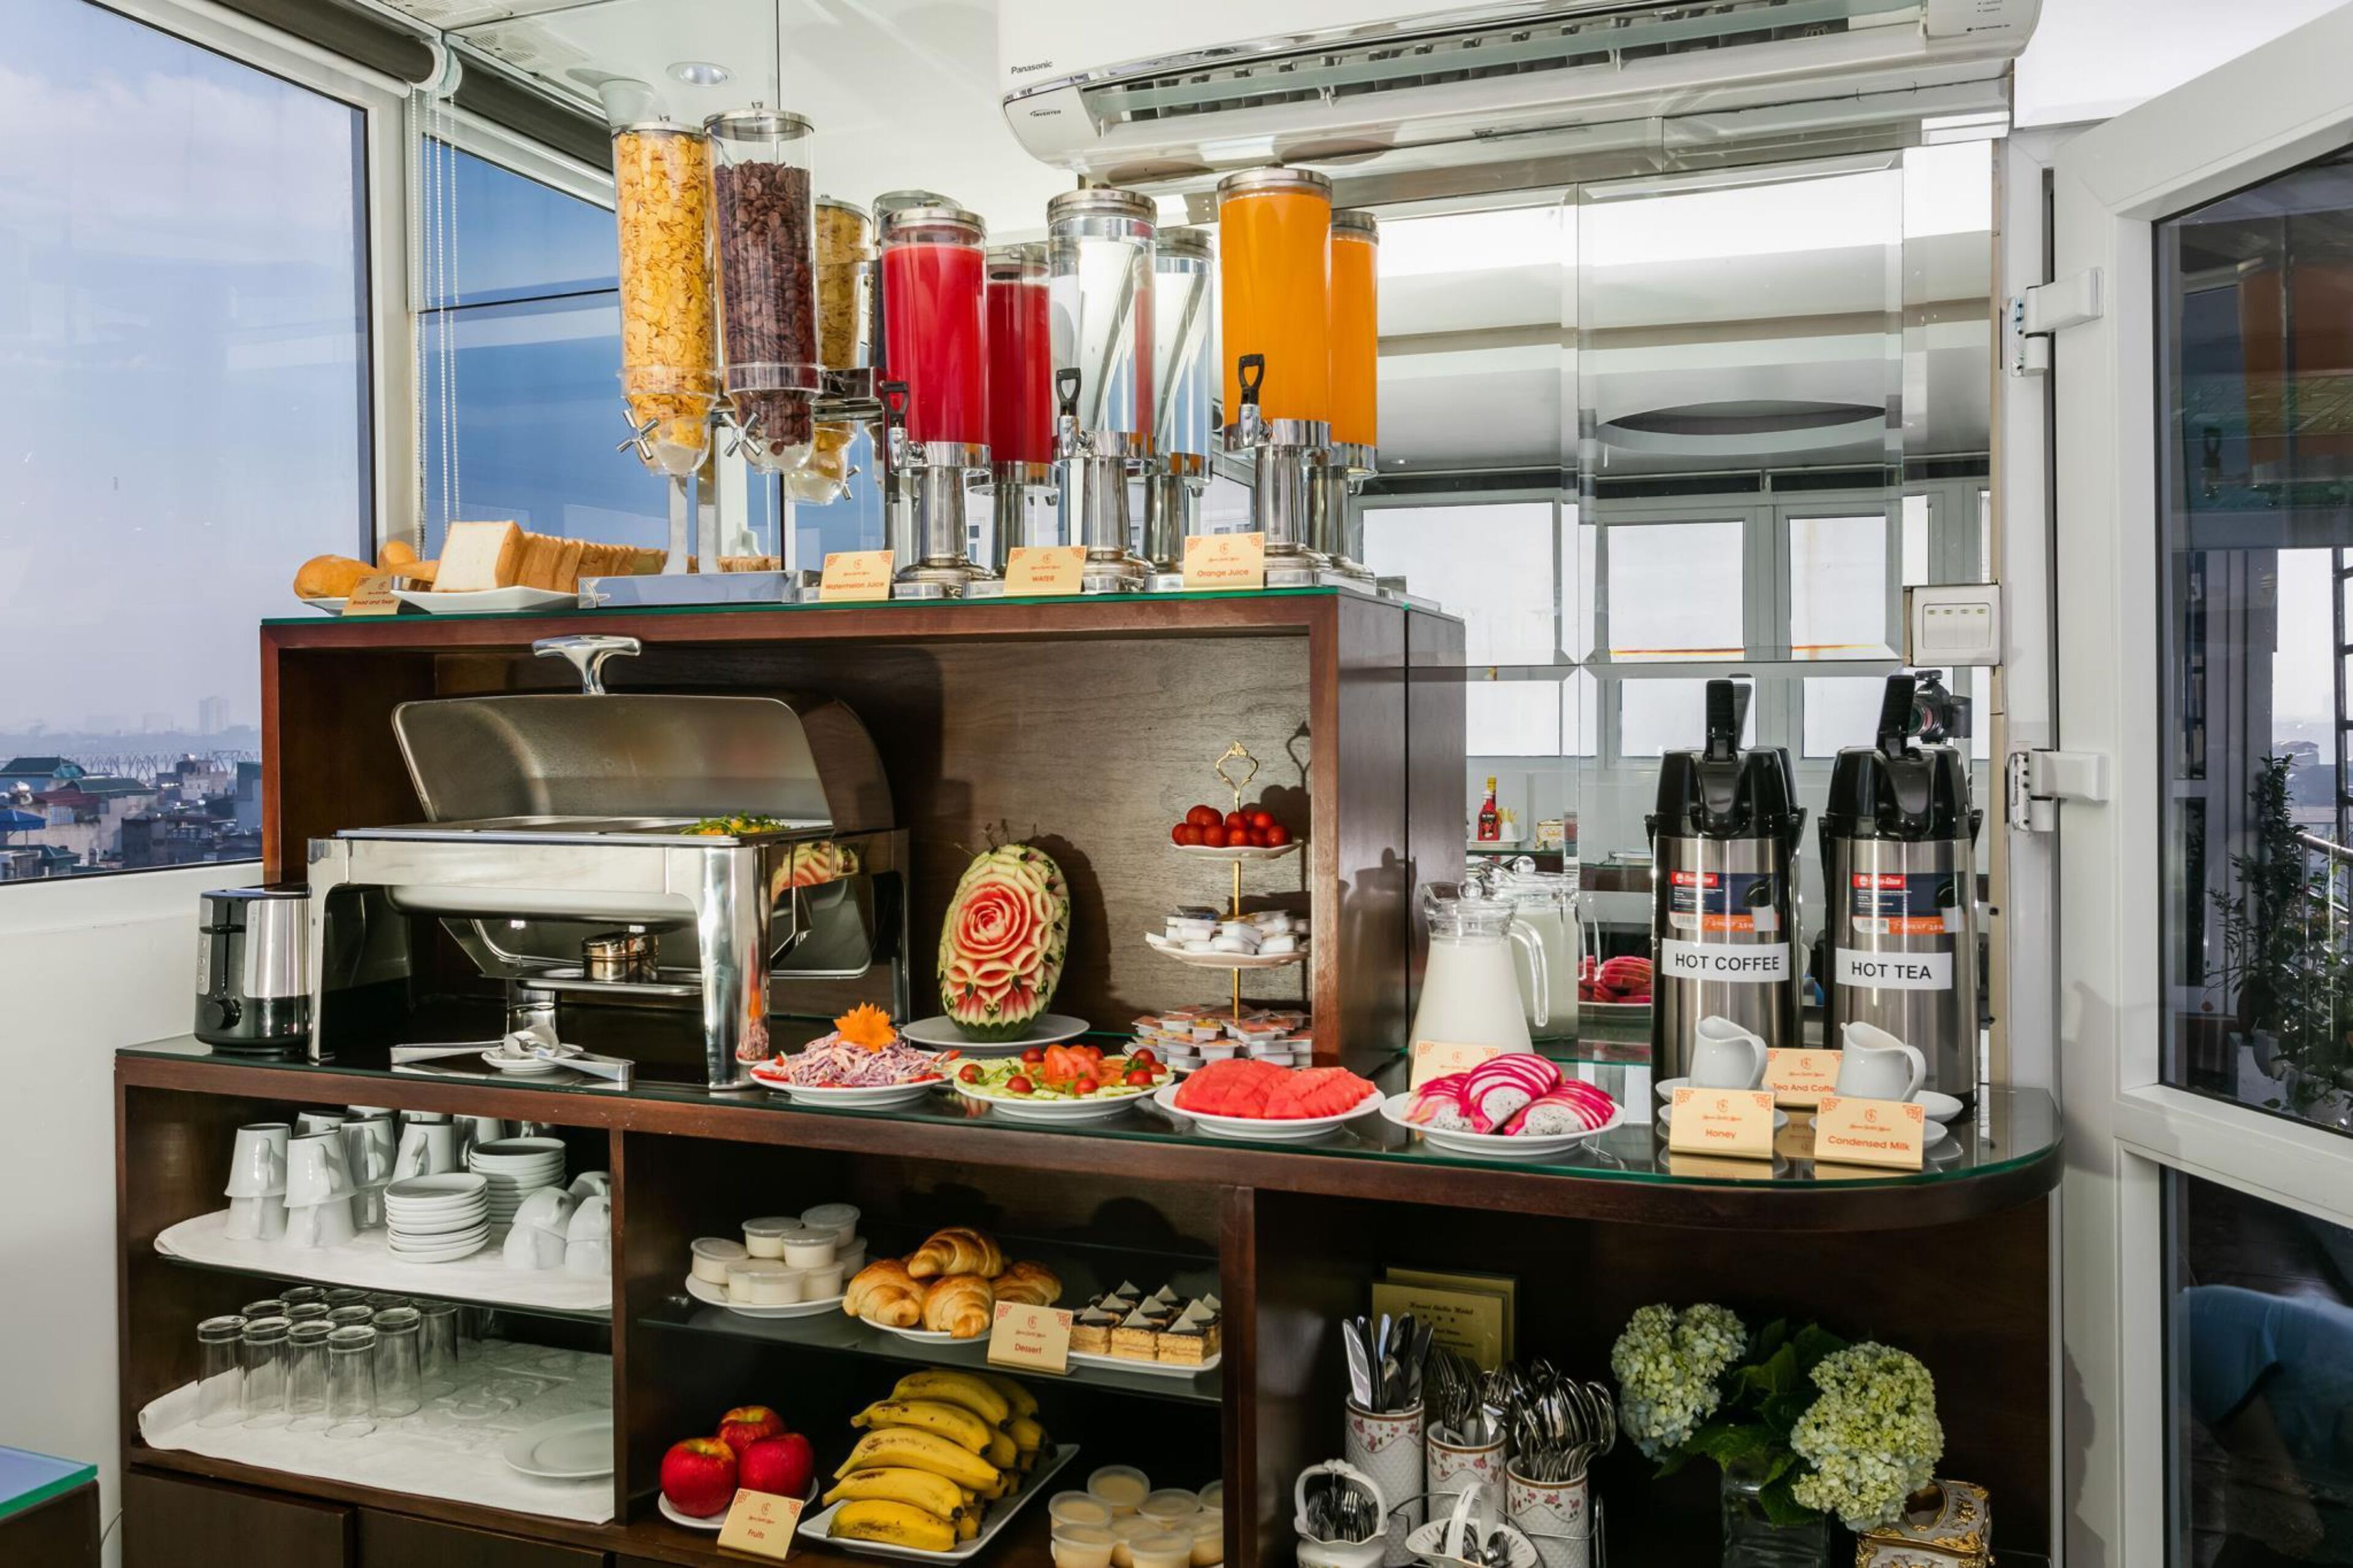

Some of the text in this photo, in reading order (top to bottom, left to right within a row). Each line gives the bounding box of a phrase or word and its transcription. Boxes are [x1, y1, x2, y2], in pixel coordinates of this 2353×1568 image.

[1011, 59, 1053, 74] Panasonic
[1675, 953, 1779, 971] HOT COFFEE
[1852, 961, 1932, 979] HOT TEA
[1705, 1129, 1737, 1139] Honey
[1828, 1135, 1911, 1151] Condensed Milk
[1015, 1343, 1042, 1355] Dessert
[748, 1528, 765, 1539] Fruits
